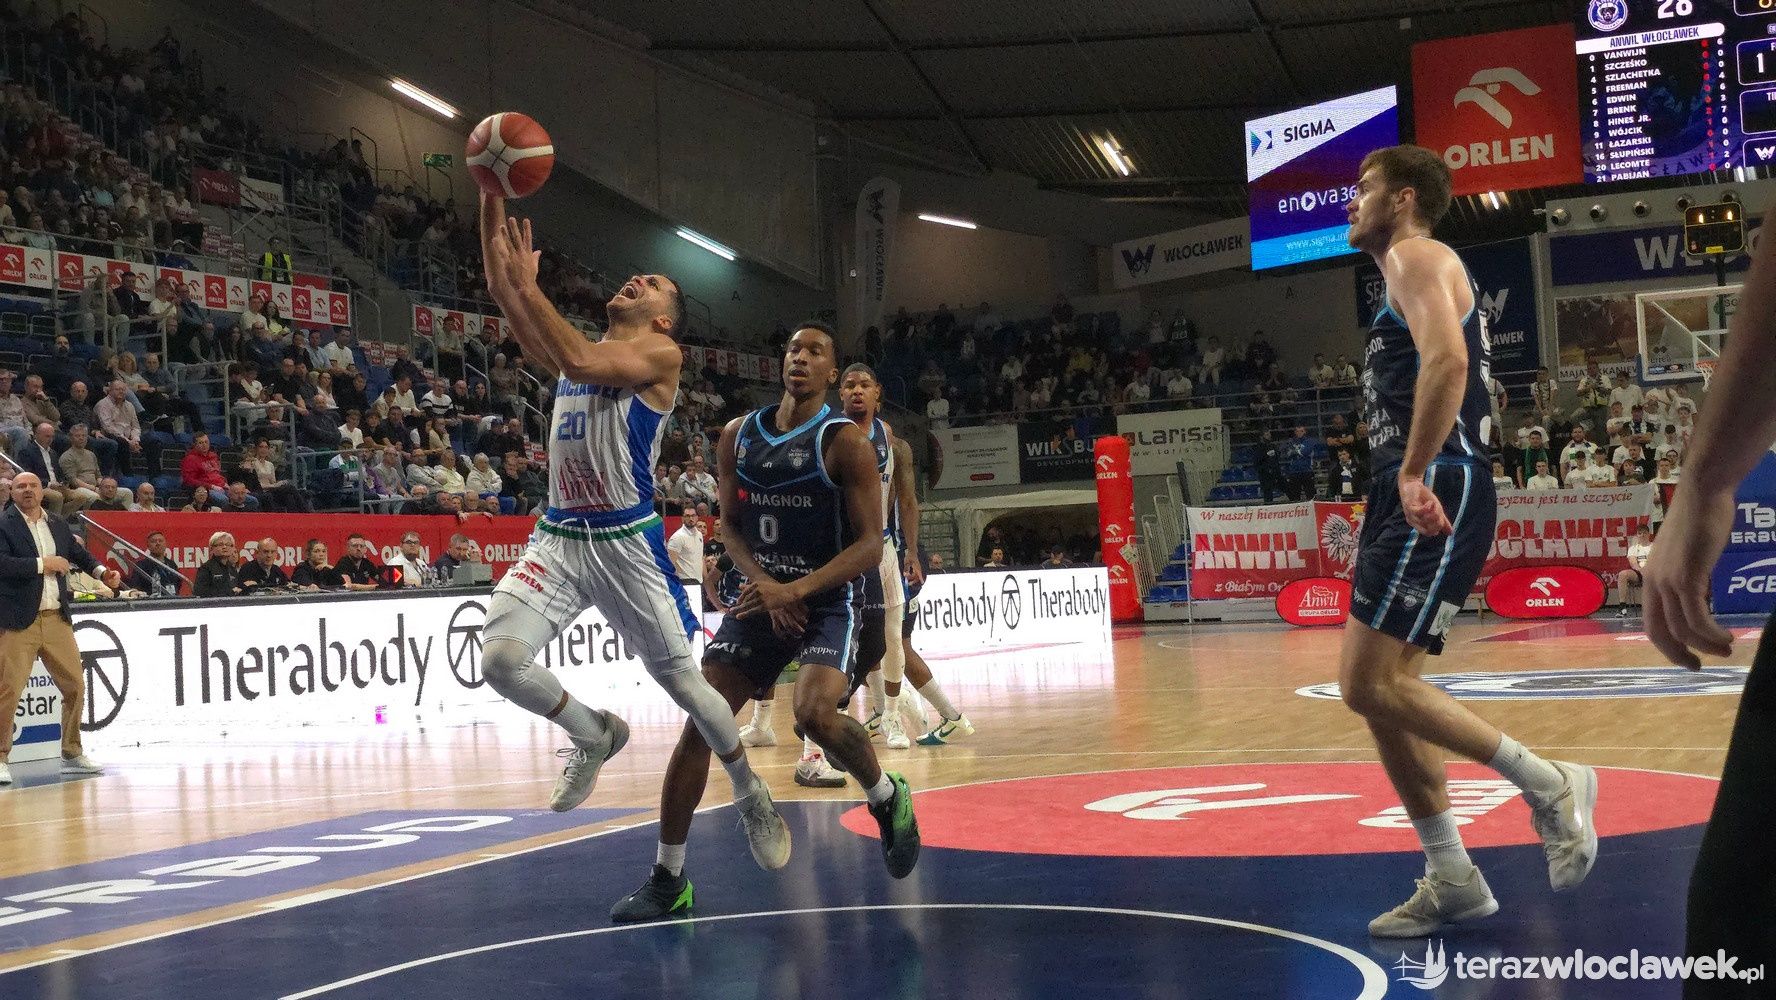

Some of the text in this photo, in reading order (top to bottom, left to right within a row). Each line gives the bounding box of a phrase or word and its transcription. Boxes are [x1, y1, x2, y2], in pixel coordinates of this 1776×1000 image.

[1609, 26, 1700, 48] ANWIL WŁOCŁAWEK
[1589, 54, 1595, 62] 0
[1603, 48, 1646, 60] VANWIJN
[1590, 65, 1594, 73] 1
[1604, 59, 1648, 71] SZCZEŚKO
[1604, 68, 1661, 82] SZLACHETKA
[1606, 81, 1647, 93] FREEMAN
[1592, 98, 1598, 106] 6
[1606, 94, 1636, 104] EDWIN
[1607, 105, 1636, 115] BRENK
[1283, 118, 1336, 143] SIGMA
[1593, 120, 1598, 128] 8
[1608, 116, 1634, 126] HINES
[1608, 126, 1643, 137] WÓJCIK
[1443, 133, 1555, 170] ORLEN
[1594, 142, 1604, 150] 11
[1608, 137, 1652, 148] ŁAZARSKI
[1596, 164, 1606, 172] 20
[1610, 160, 1650, 170] LECOMTE
[1596, 175, 1606, 183] 21
[1611, 170, 1650, 182] PABIJAN
[1278, 184, 1358, 214] enova36
[1163, 234, 1243, 263] WŁOCŁAWEK
[557, 410, 587, 441] 20
[750, 492, 813, 508] MAGNOR
[1562, 495, 1578, 504] na
[1582, 489, 1633, 507] szczycie
[759, 513, 779, 545] 0
[1195, 532, 1307, 570] ANWIL
[510, 570, 545, 593] ORLEN
[1027, 574, 1108, 626] Therabody
[1299, 588, 1339, 608] Anwil
[1525, 598, 1565, 607] ORLEN
[915, 581, 997, 638] herabody
[157, 612, 434, 706] Therabody
